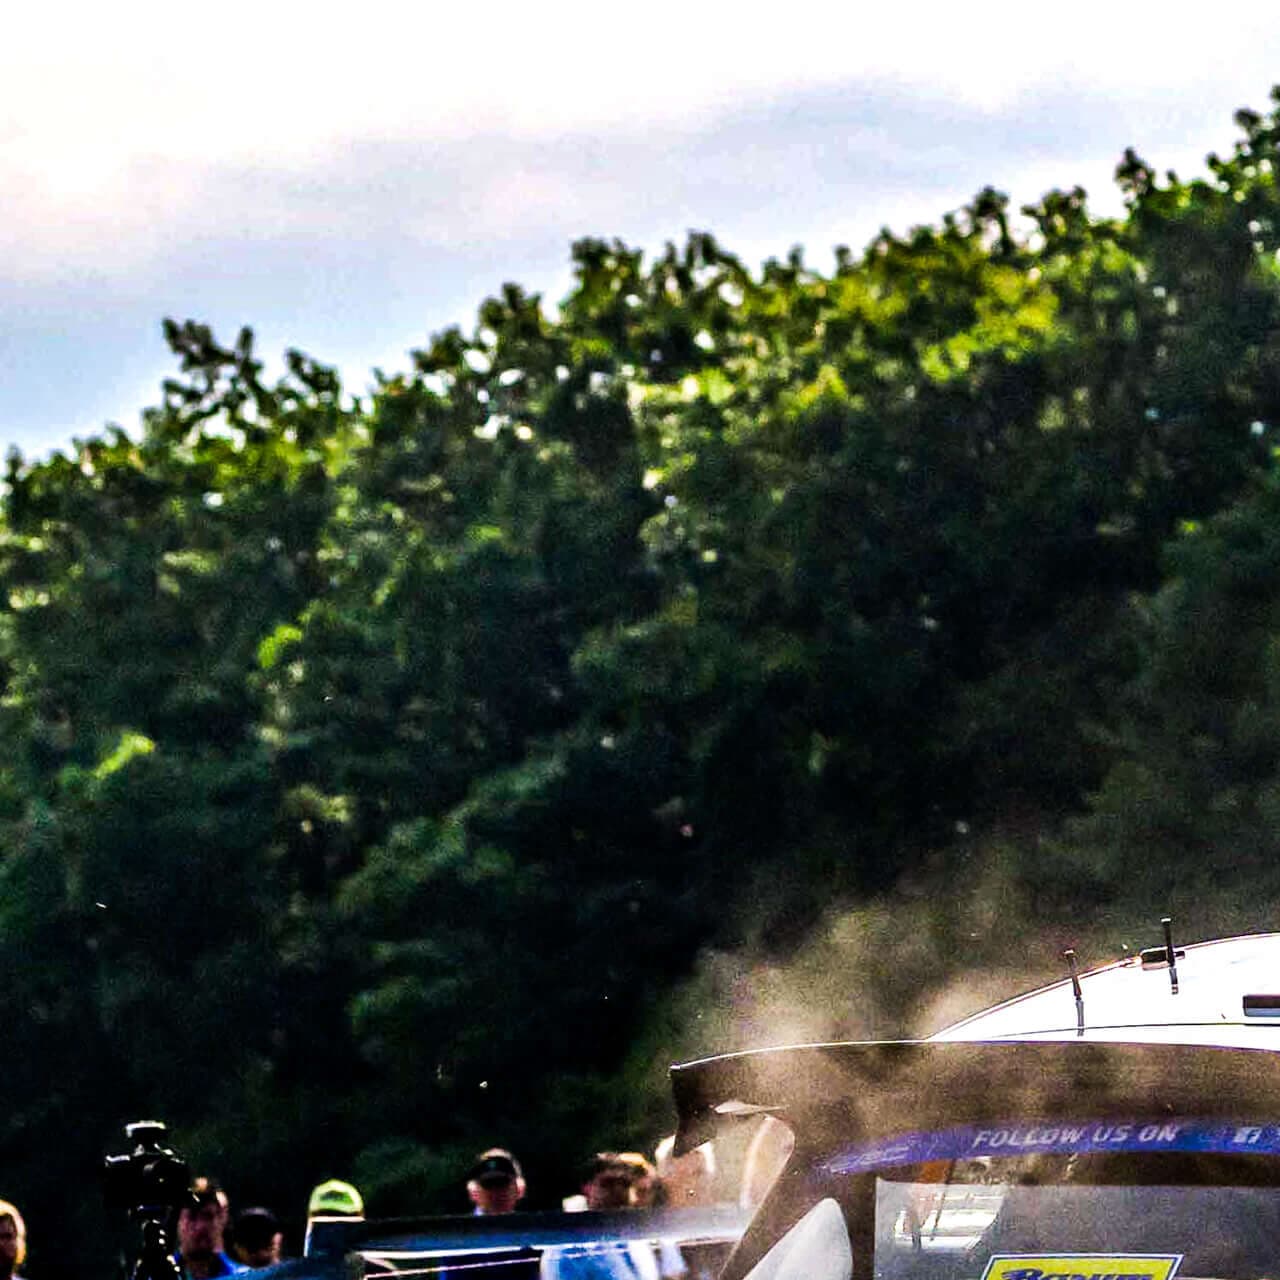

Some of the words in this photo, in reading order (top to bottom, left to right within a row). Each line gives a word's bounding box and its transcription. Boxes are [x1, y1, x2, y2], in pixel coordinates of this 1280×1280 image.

[972, 1127, 1082, 1149] FOLLOW
[1092, 1126, 1129, 1145] US
[1139, 1125, 1178, 1144] ON
